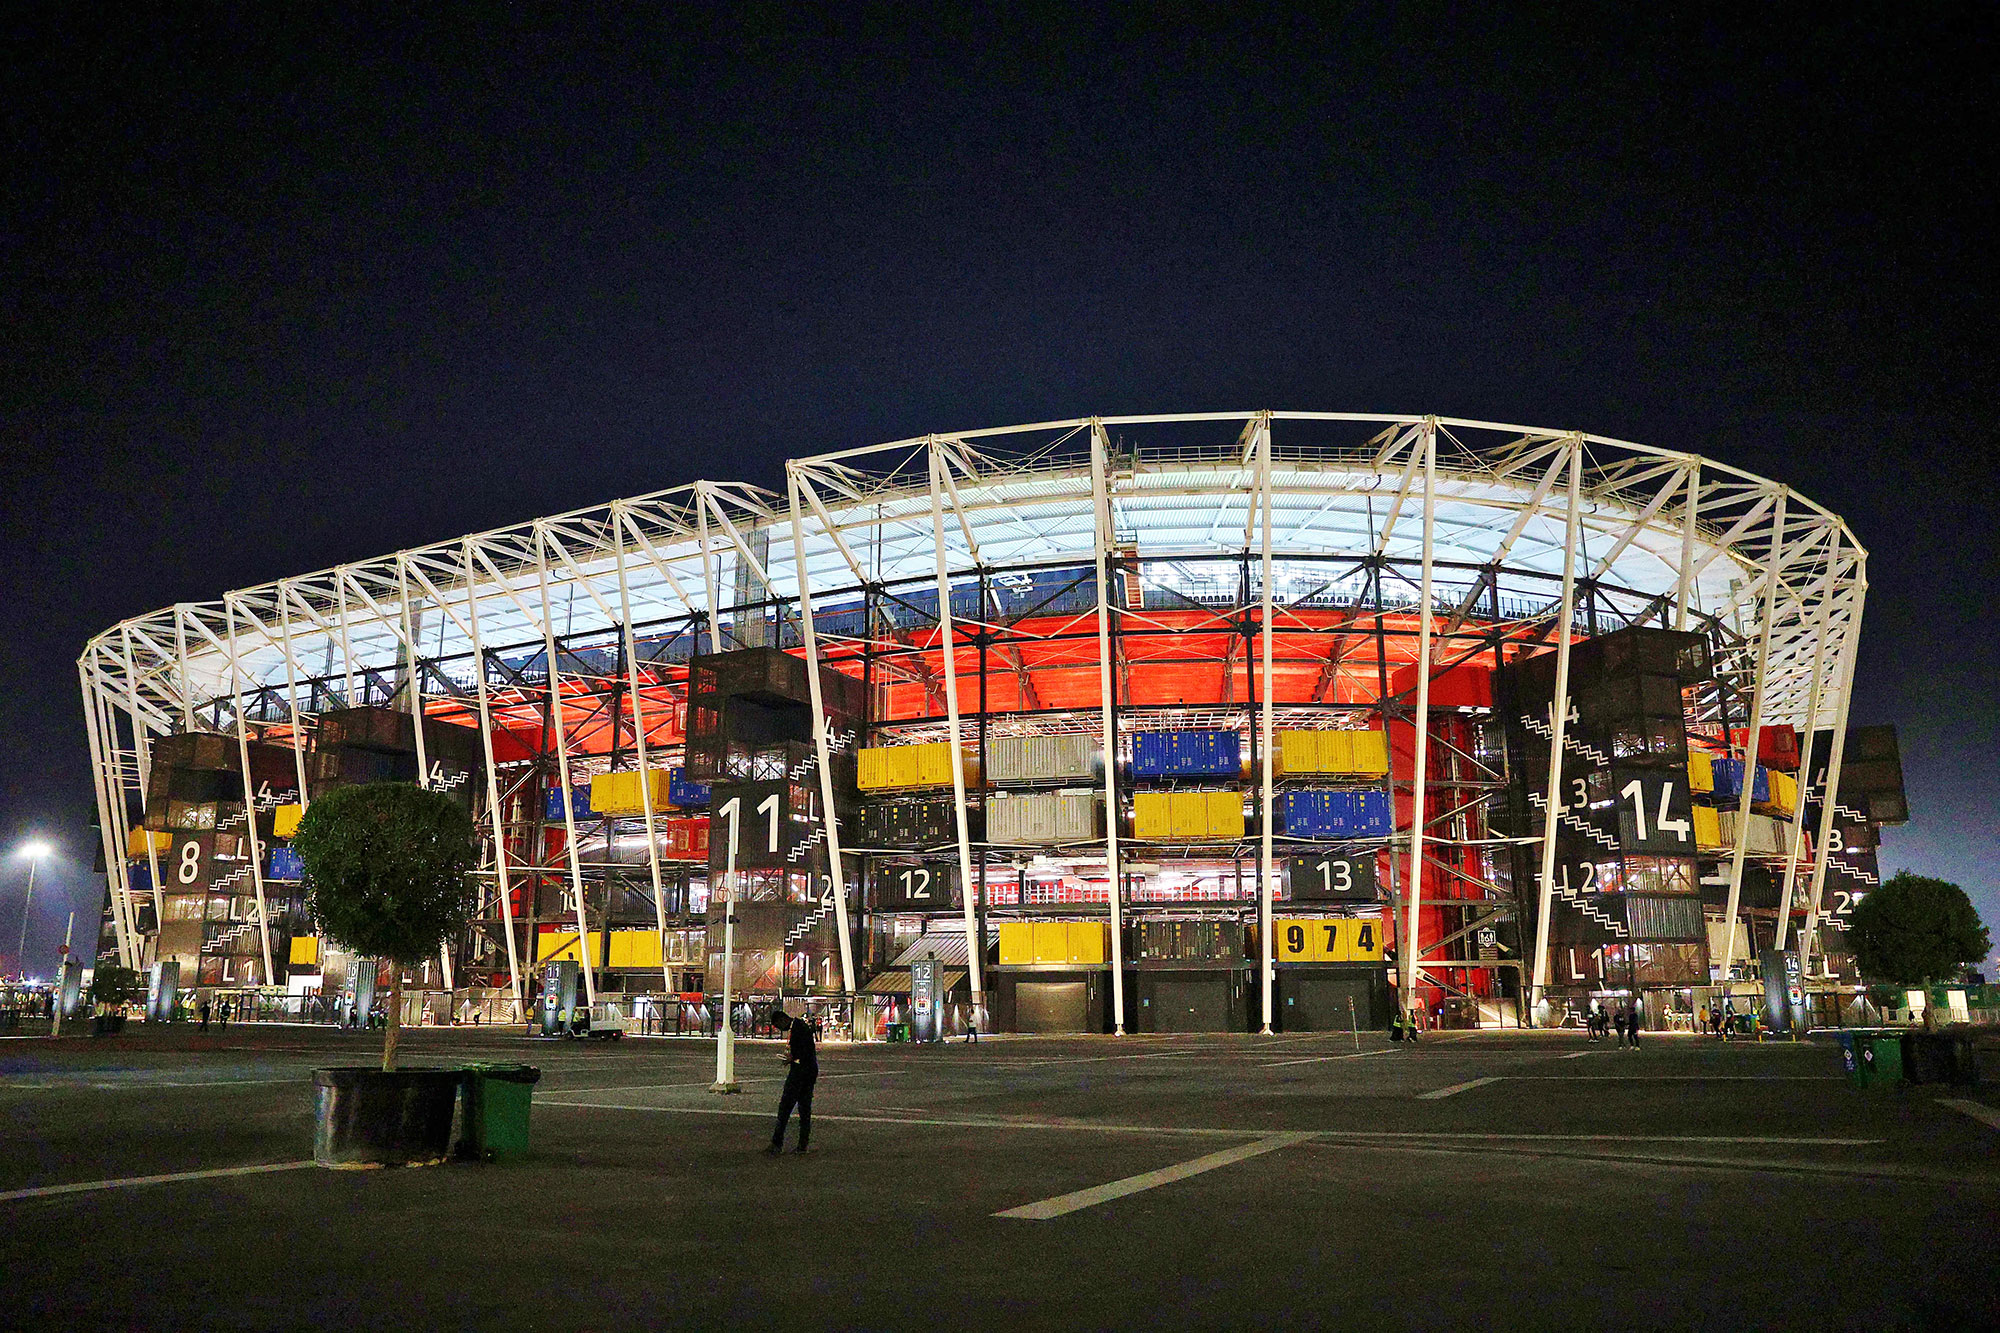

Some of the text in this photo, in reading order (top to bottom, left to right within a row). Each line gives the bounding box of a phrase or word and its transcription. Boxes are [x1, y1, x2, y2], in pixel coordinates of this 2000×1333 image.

[718, 794, 780, 855] 11
[1620, 779, 1690, 842] 14
[178, 840, 200, 884] 8
[1316, 860, 1352, 891] 13
[807, 873, 832, 904] L2
[900, 869, 930, 899] 12
[1563, 862, 1596, 896] L2
[230, 898, 259, 921] L2
[223, 959, 253, 981] L1
[547, 965, 560, 977] 11
[805, 955, 831, 985] L1
[915, 967, 930, 979] 12
[1570, 948, 1604, 979] L1
[1786, 957, 1798, 969] 14
